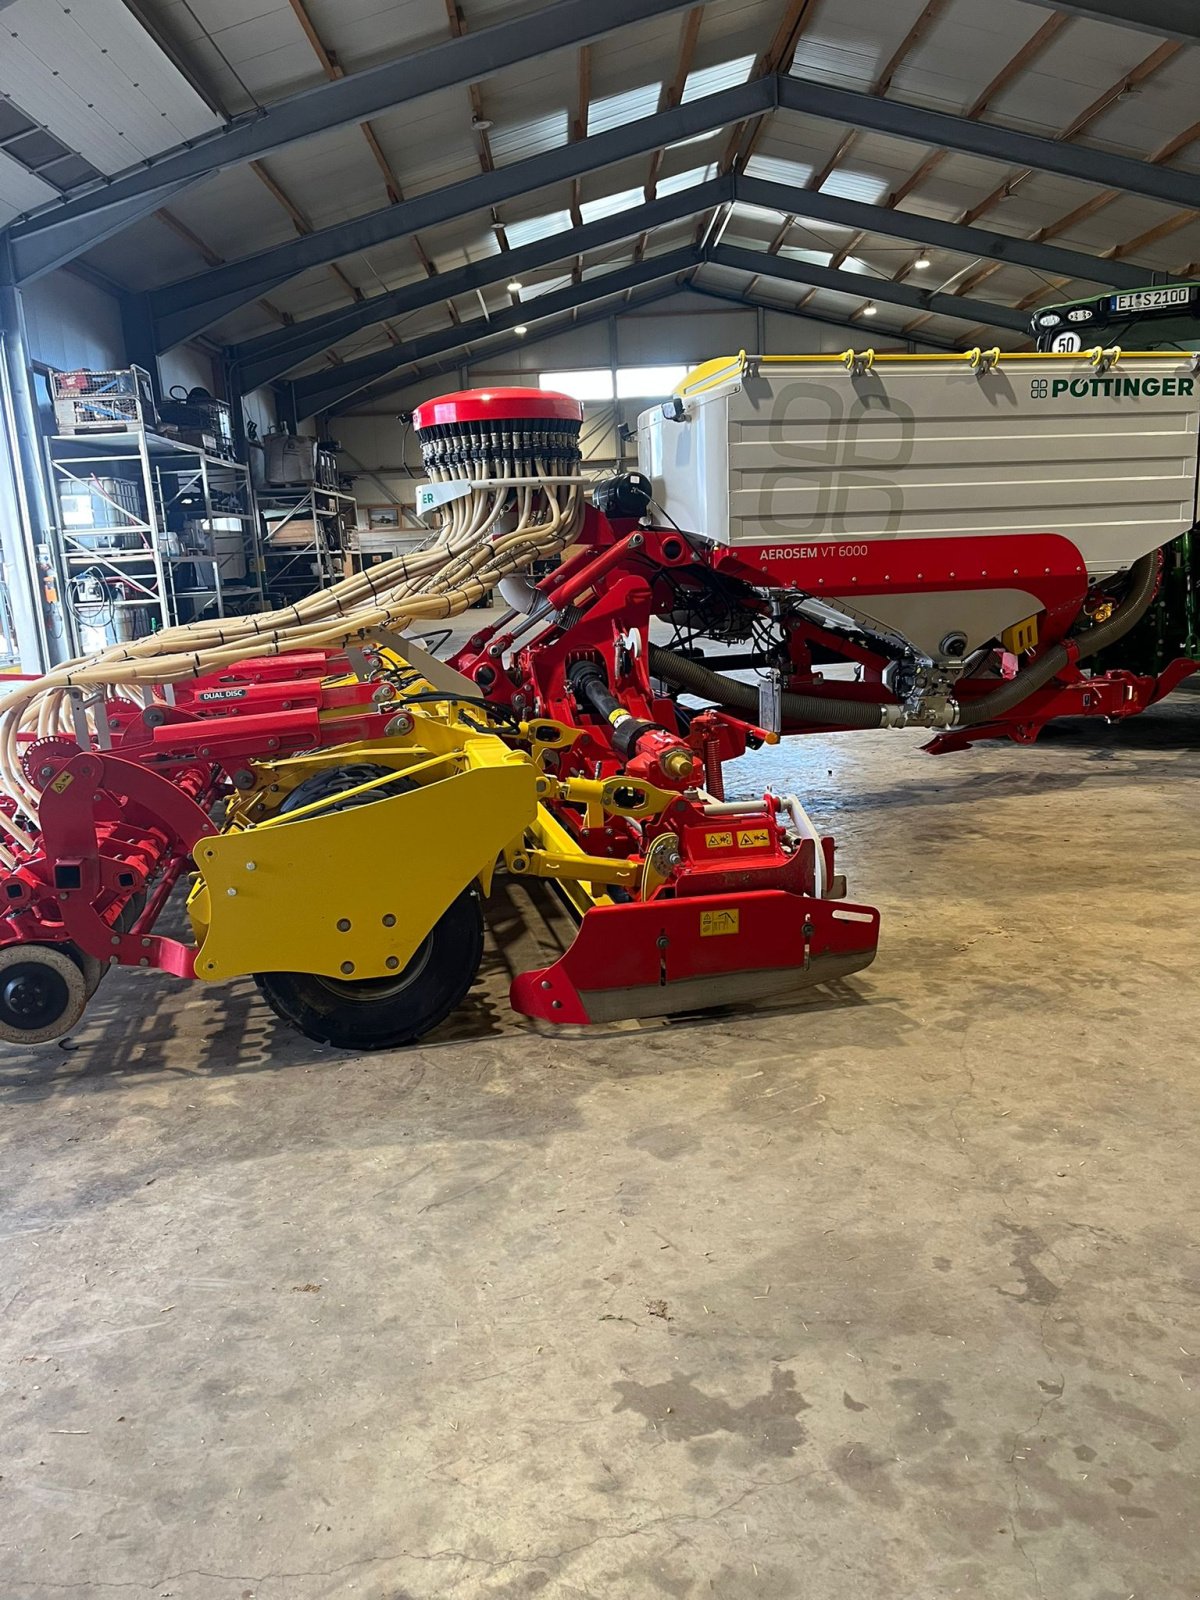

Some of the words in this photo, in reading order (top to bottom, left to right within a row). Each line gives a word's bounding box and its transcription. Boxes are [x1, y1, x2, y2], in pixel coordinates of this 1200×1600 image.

[1057, 336, 1075, 353] 50
[1052, 377, 1194, 398] PÖTTINGER
[760, 547, 818, 560] AEROSEM
[820, 546, 836, 557] VT
[838, 544, 868, 557] 6000
[203, 692, 225, 700] DUAL
[225, 690, 243, 698] DISC
